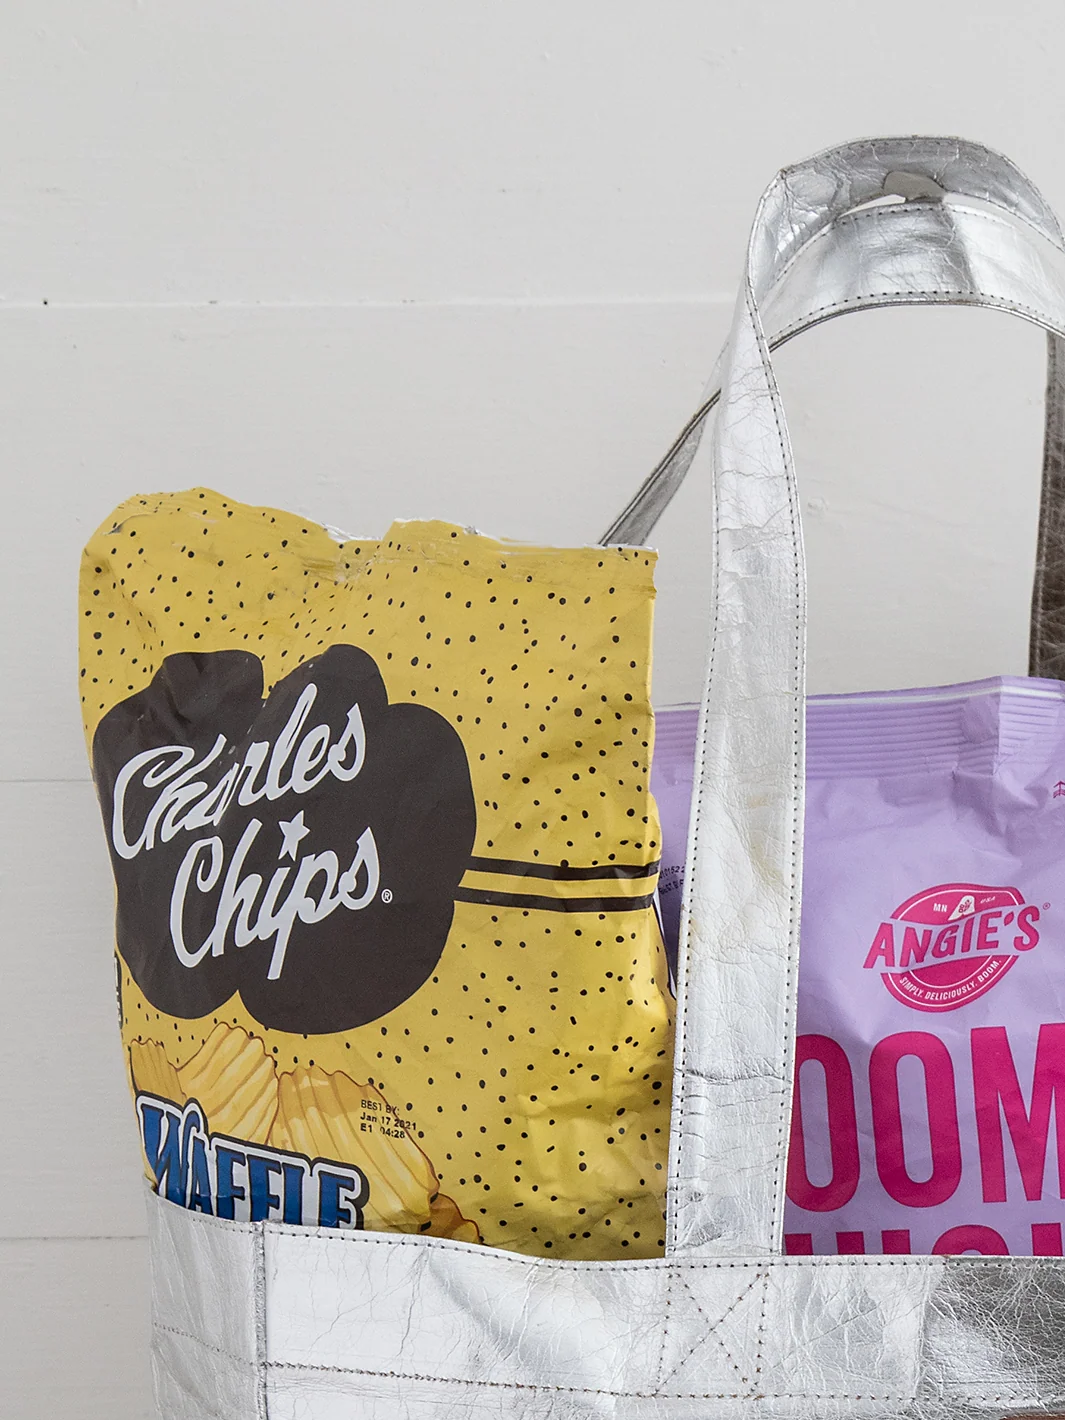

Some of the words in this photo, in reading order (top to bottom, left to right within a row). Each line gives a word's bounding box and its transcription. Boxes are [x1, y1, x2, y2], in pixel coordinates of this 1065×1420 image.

[113, 683, 366, 859] Charles
[170, 811, 380, 980] Chips
[933, 902, 948, 913] MN
[863, 905, 1041, 969] ANGIE'S
[899, 976, 923, 998] SIMPLY.
[925, 981, 978, 1001] DELICIOUSLY.
[977, 960, 1002, 982] BOOM.
[360, 1112, 378, 1122] Jan
[381, 1116, 391, 1125] 17
[394, 1119, 417, 1130] 2021
[360, 1123, 372, 1133] E1
